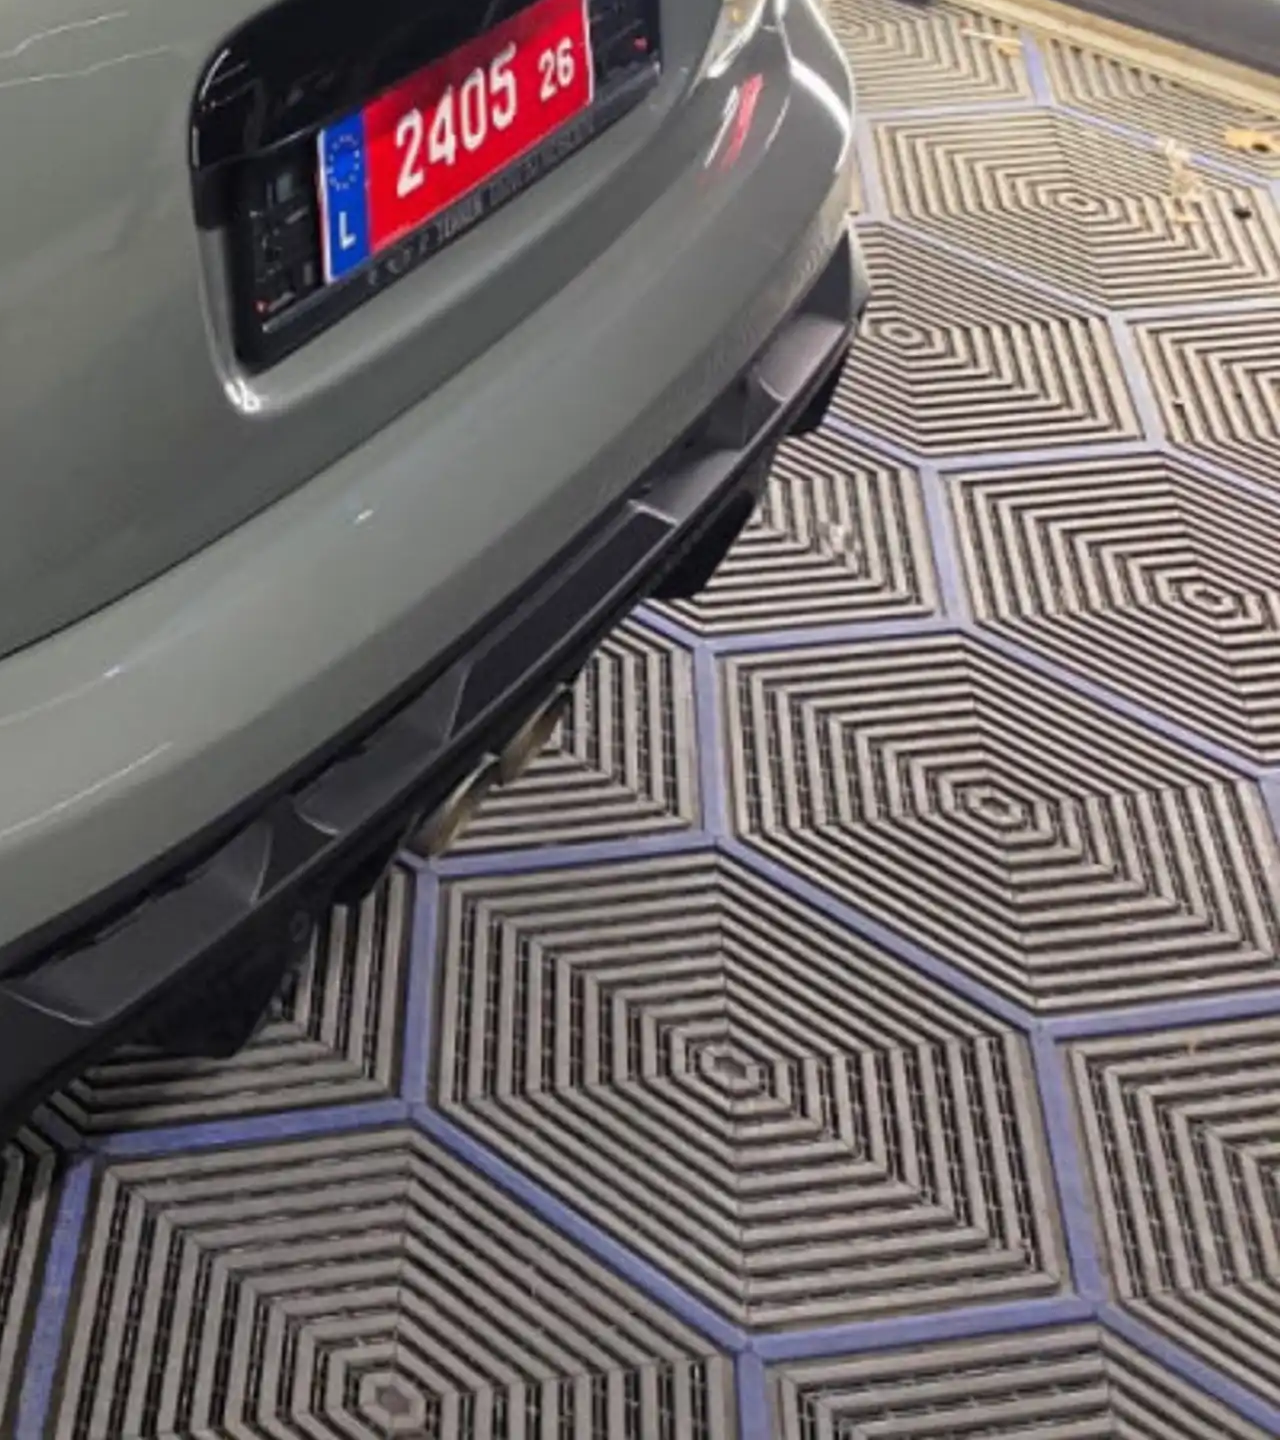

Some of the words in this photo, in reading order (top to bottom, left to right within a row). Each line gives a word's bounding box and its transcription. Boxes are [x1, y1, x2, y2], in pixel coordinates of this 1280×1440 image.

[395, 41, 517, 199] 2405
[538, 36, 575, 101] 26
[339, 211, 356, 250] L
